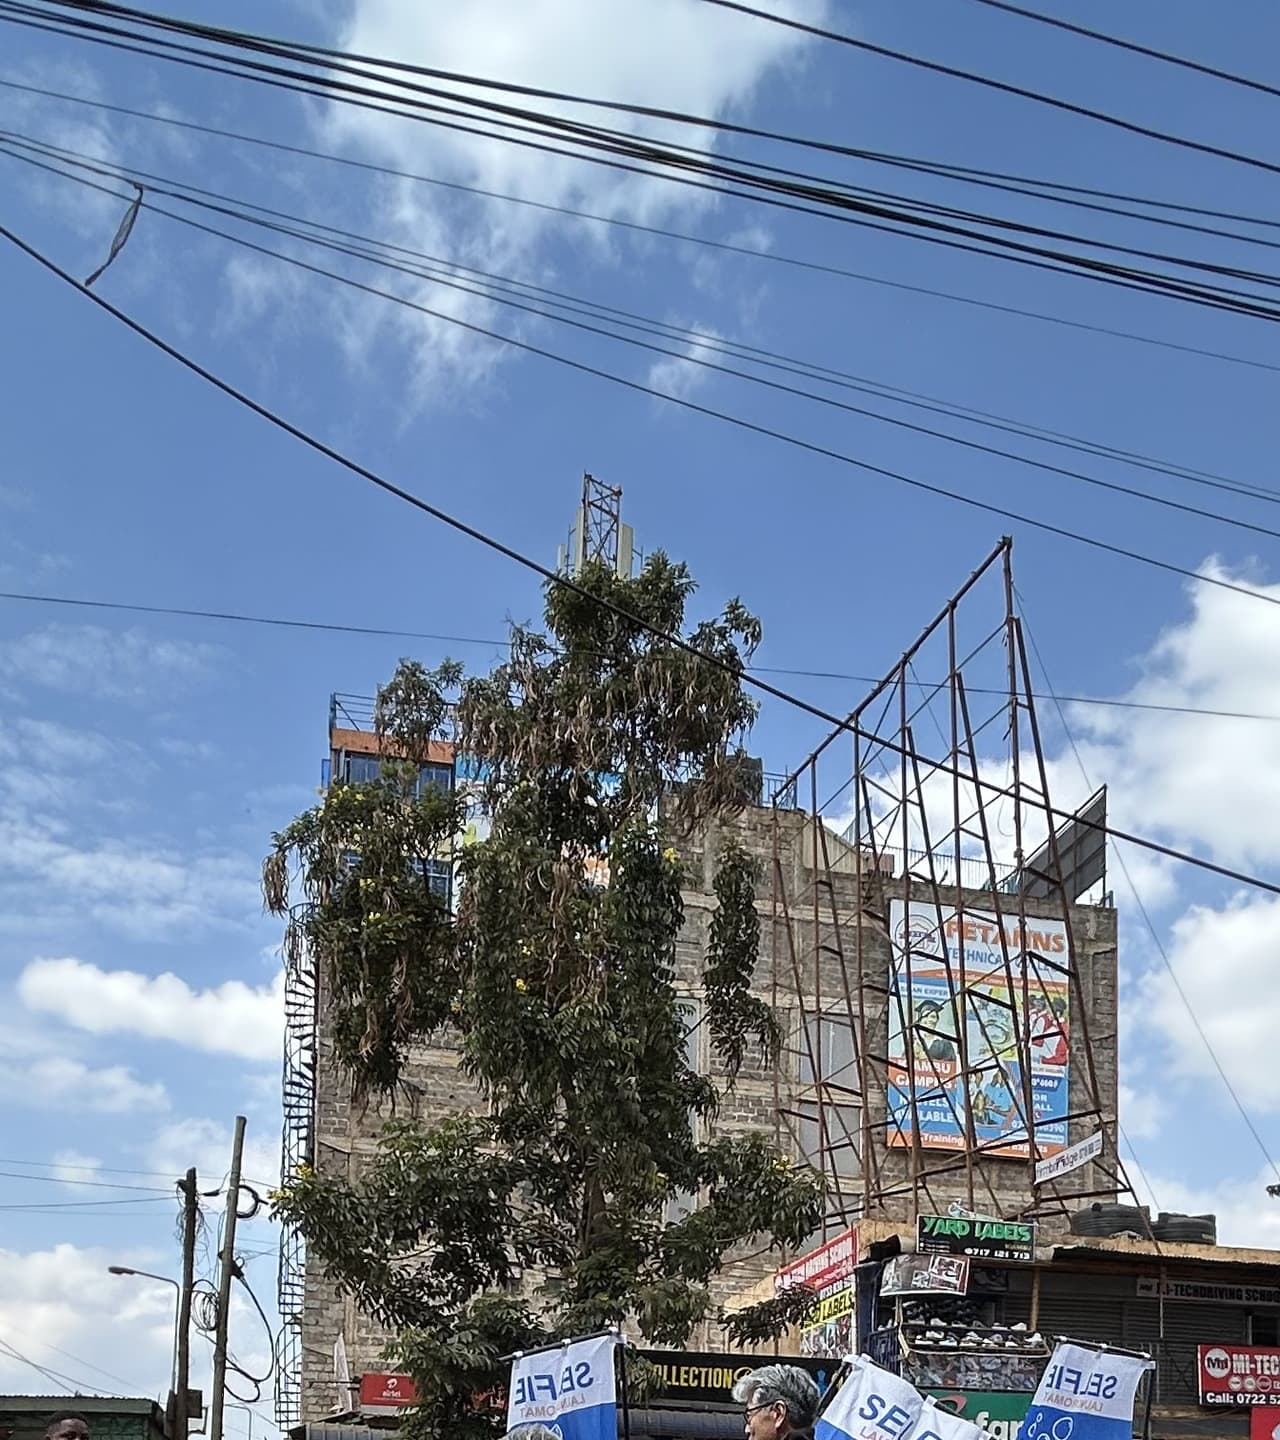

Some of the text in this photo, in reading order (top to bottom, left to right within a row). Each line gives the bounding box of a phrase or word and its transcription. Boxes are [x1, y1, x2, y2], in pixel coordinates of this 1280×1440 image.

[946, 947, 1005, 966] TEHNICA
[923, 1217, 1032, 1241] YARD LABELS
[382, 1390, 402, 1399] airtel
[1206, 1392, 1234, 1404] Call:
[1237, 1394, 1266, 1405] 0722
